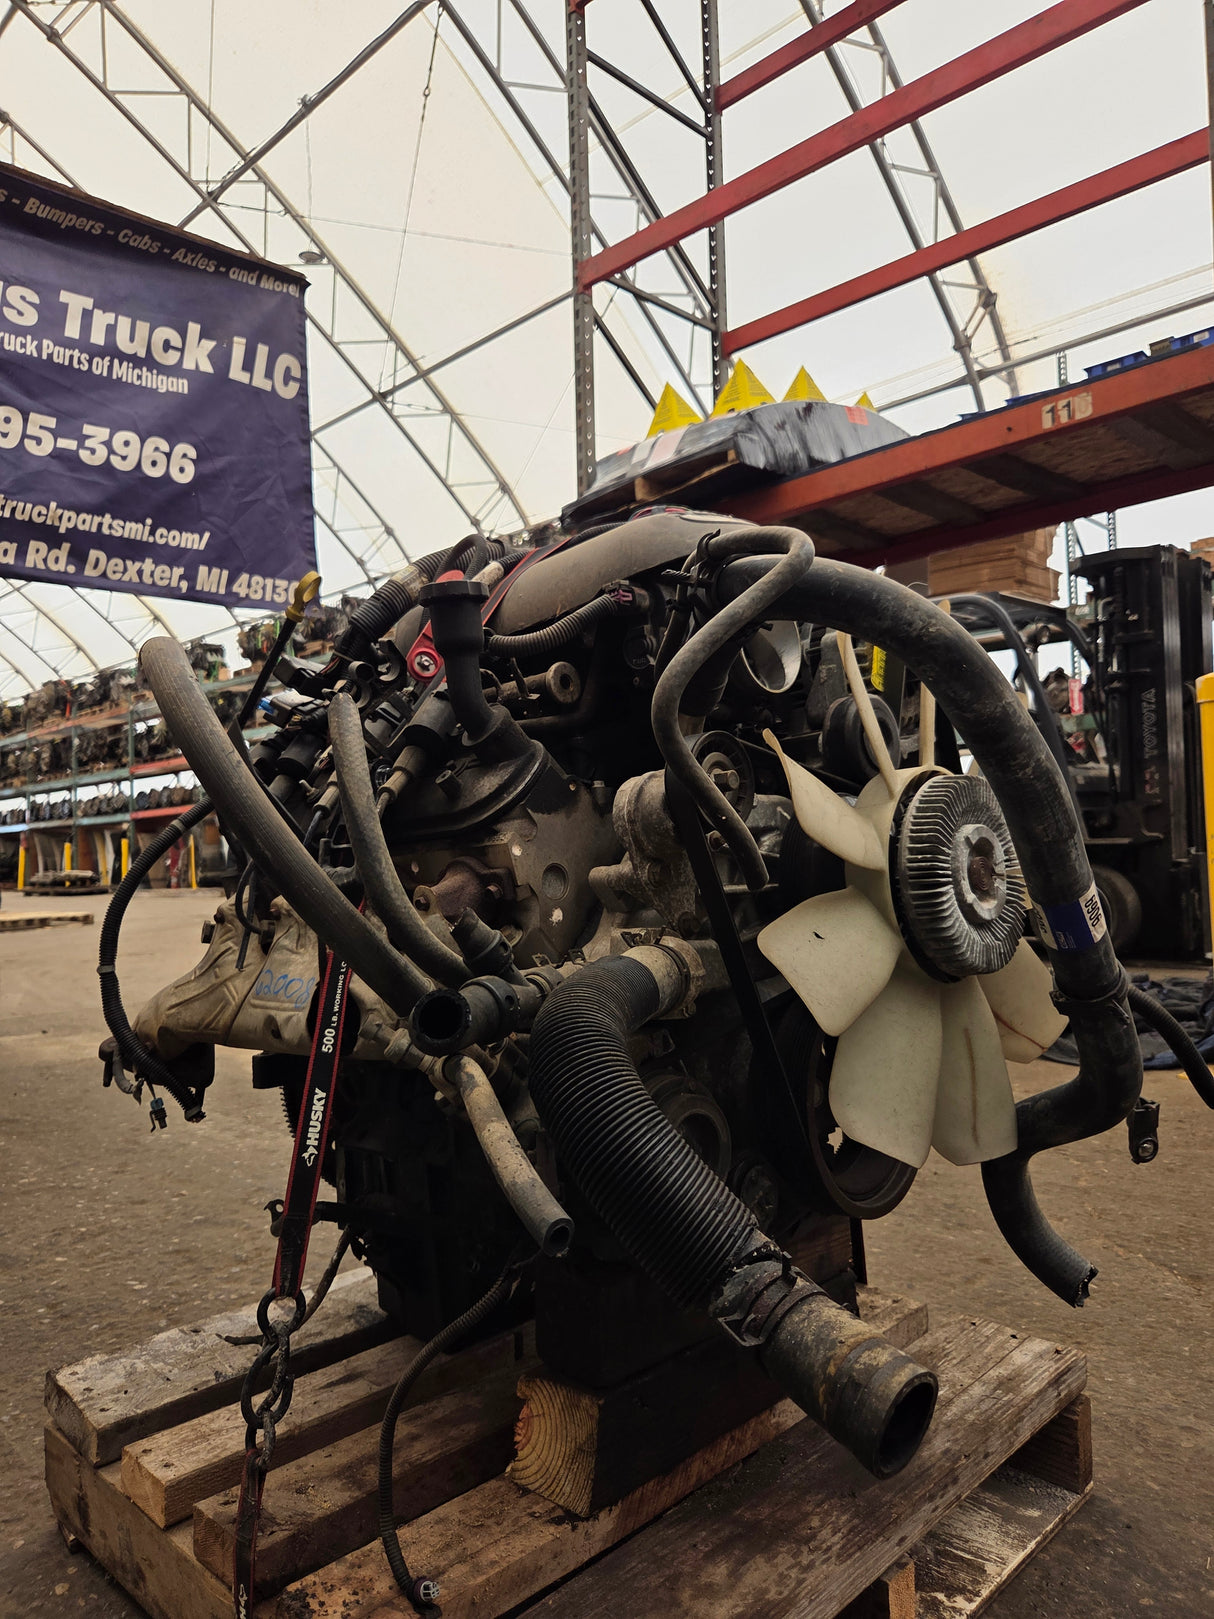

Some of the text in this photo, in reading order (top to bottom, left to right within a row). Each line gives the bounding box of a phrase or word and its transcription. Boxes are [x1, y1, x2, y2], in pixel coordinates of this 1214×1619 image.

[23, 197, 105, 235] Bumpers
[117, 228, 161, 254] Cabs
[171, 248, 217, 272] Axles
[228, 266, 260, 286] and
[0, 281, 302, 400] s Truck LLC
[42, 338, 89, 371] Parts
[92, 356, 111, 377] of
[112, 358, 189, 394] Michigan
[0, 405, 197, 484] 95-3966
[25, 540, 76, 574] Rd.
[83, 548, 188, 593] Dexter,
[195, 564, 229, 594] MI
[1142, 687, 1159, 759] TOYOTA
[331, 1013, 339, 1027] LB.
[333, 974, 345, 1012] WORKING
[321, 1028, 336, 1054] 500
[306, 1087, 327, 1146] HUSKY
